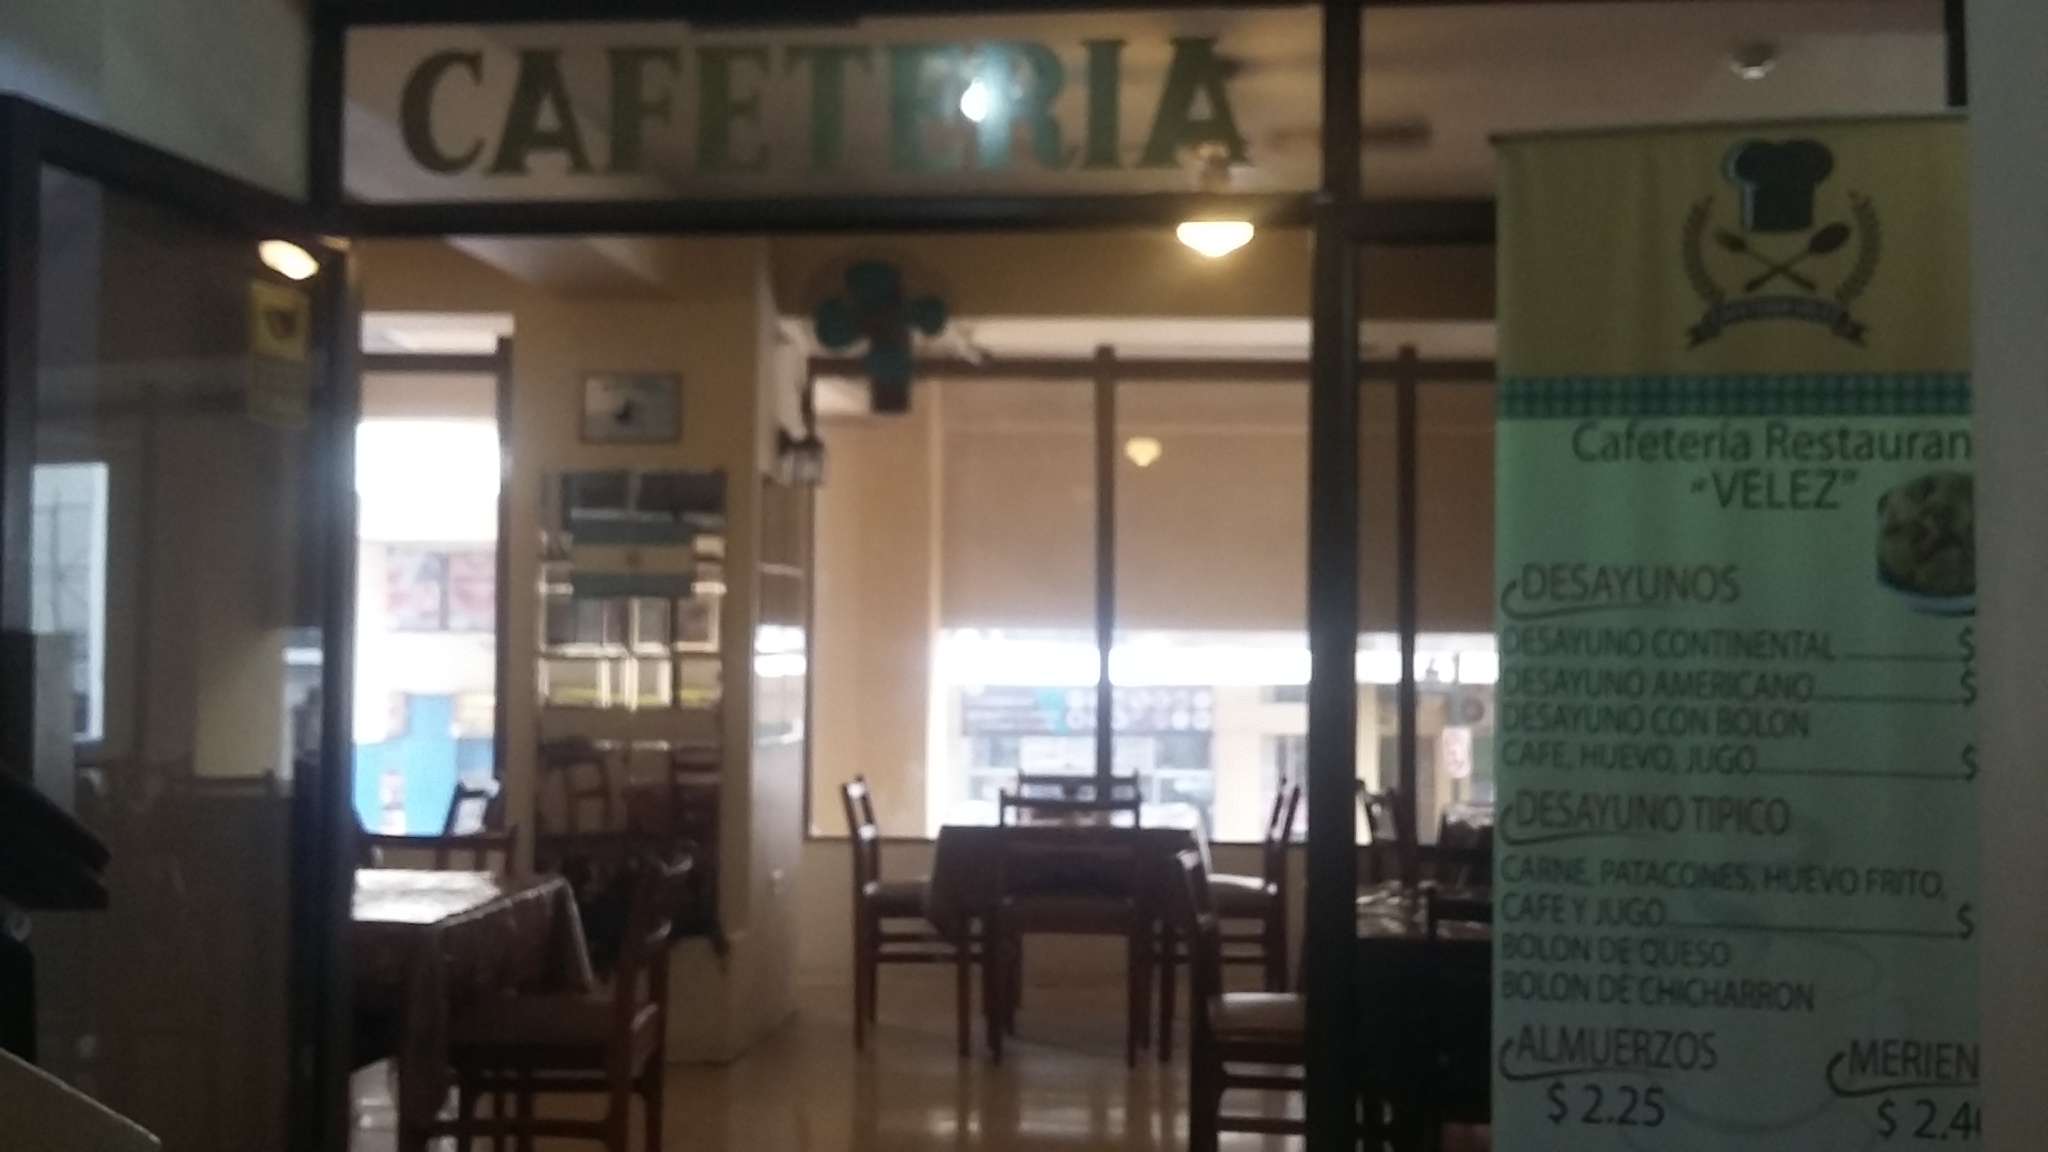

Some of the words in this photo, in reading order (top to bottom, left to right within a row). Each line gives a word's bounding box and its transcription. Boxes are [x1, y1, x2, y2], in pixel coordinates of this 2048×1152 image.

[400, 34, 1251, 178] CAFETERIA
[1521, 562, 1741, 602] DESAYUNOS
[1501, 626, 1643, 659] DESAYUNO
[1651, 628, 1837, 662] CONTINENTAL
[1502, 669, 1643, 700] DESAYUNO
[1652, 671, 1816, 702] AMERICANO
[1502, 703, 1642, 735] DESAYUNO
[1651, 706, 1711, 738] CON
[1716, 706, 1811, 739] BOLON
[1687, 744, 1759, 776] JUGO
[1516, 790, 1686, 833] DESAYUNO
[1690, 794, 1791, 836] TIPICO
[1763, 866, 1860, 897] HUEVO
[1501, 893, 1565, 923] CAFE
[1596, 897, 1666, 928] JUGO
[1502, 934, 1590, 961] BOLON
[1600, 936, 1636, 963] DE
[1638, 937, 1732, 967] QUESO
[1502, 970, 1590, 1000] BOLON
[1600, 974, 1634, 1003] DE
[1639, 974, 1815, 1010] CHICHARRON
[1517, 1024, 1719, 1071] ALMUERZOS
[1547, 1081, 1567, 1125] $
[1581, 1085, 1666, 1127] 2.25
[1877, 1099, 1898, 1139] $
[1913, 1099, 1981, 1140] 2.4
